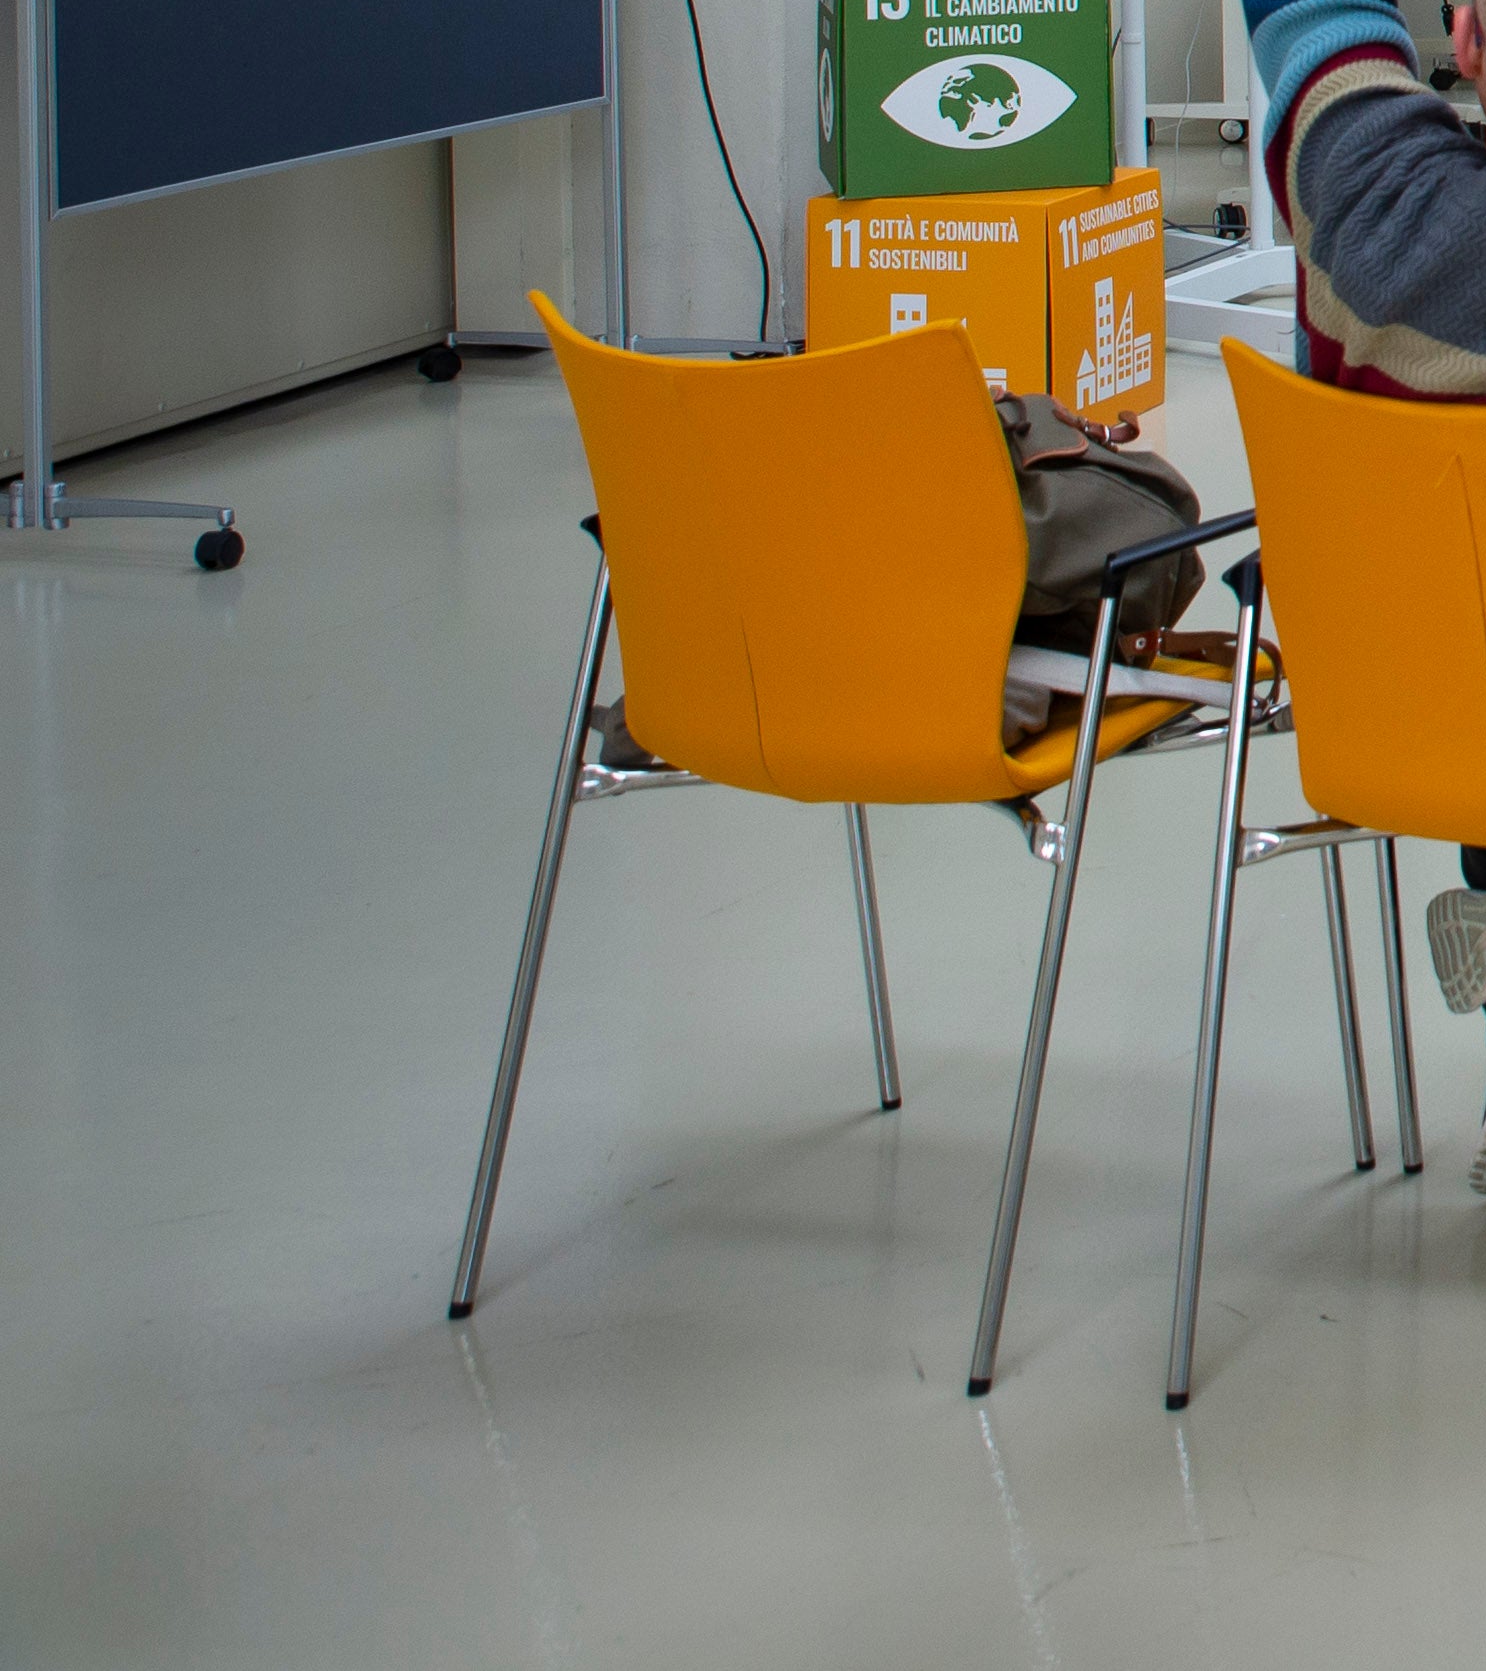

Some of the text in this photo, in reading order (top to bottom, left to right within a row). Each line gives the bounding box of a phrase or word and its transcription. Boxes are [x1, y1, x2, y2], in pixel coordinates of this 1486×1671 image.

[925, 23, 1022, 48] CLIMATICO
[825, 214, 1019, 268] 11 CITTÀ E COMUNITÀ
[1058, 189, 1159, 269] 11 SUSTAINABLE CITIES
[1082, 219, 1155, 263] AND COMMUNITIES
[869, 248, 967, 271] SOSTENIBILI
